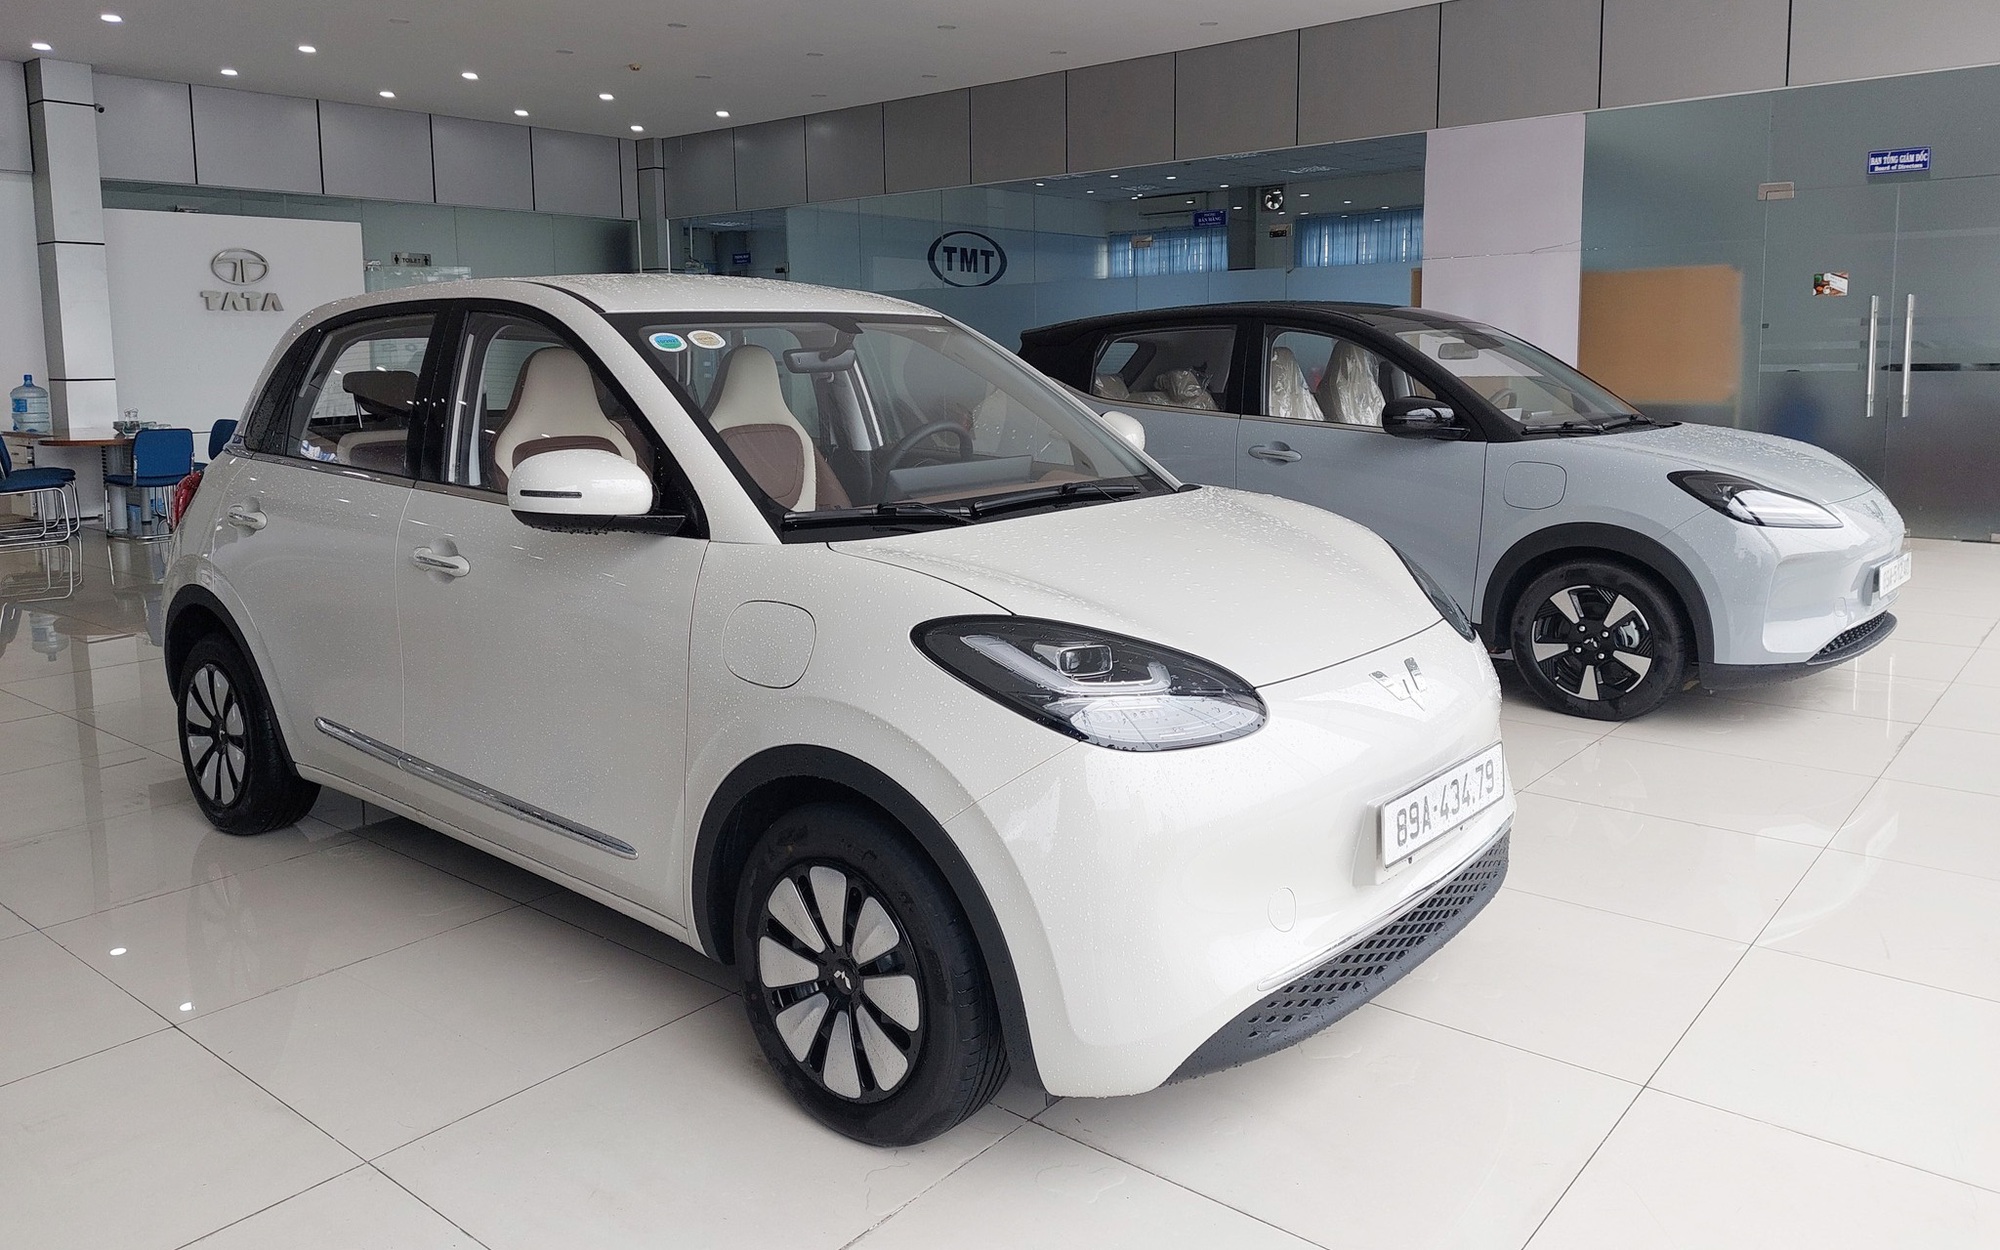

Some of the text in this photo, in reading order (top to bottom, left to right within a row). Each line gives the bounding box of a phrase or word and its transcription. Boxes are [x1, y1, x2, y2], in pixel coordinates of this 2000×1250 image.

[1870, 156, 1882, 165] BAN
[942, 246, 995, 274] TMT
[200, 291, 284, 311] TATA
[1396, 759, 1494, 847] 89A-434.79
